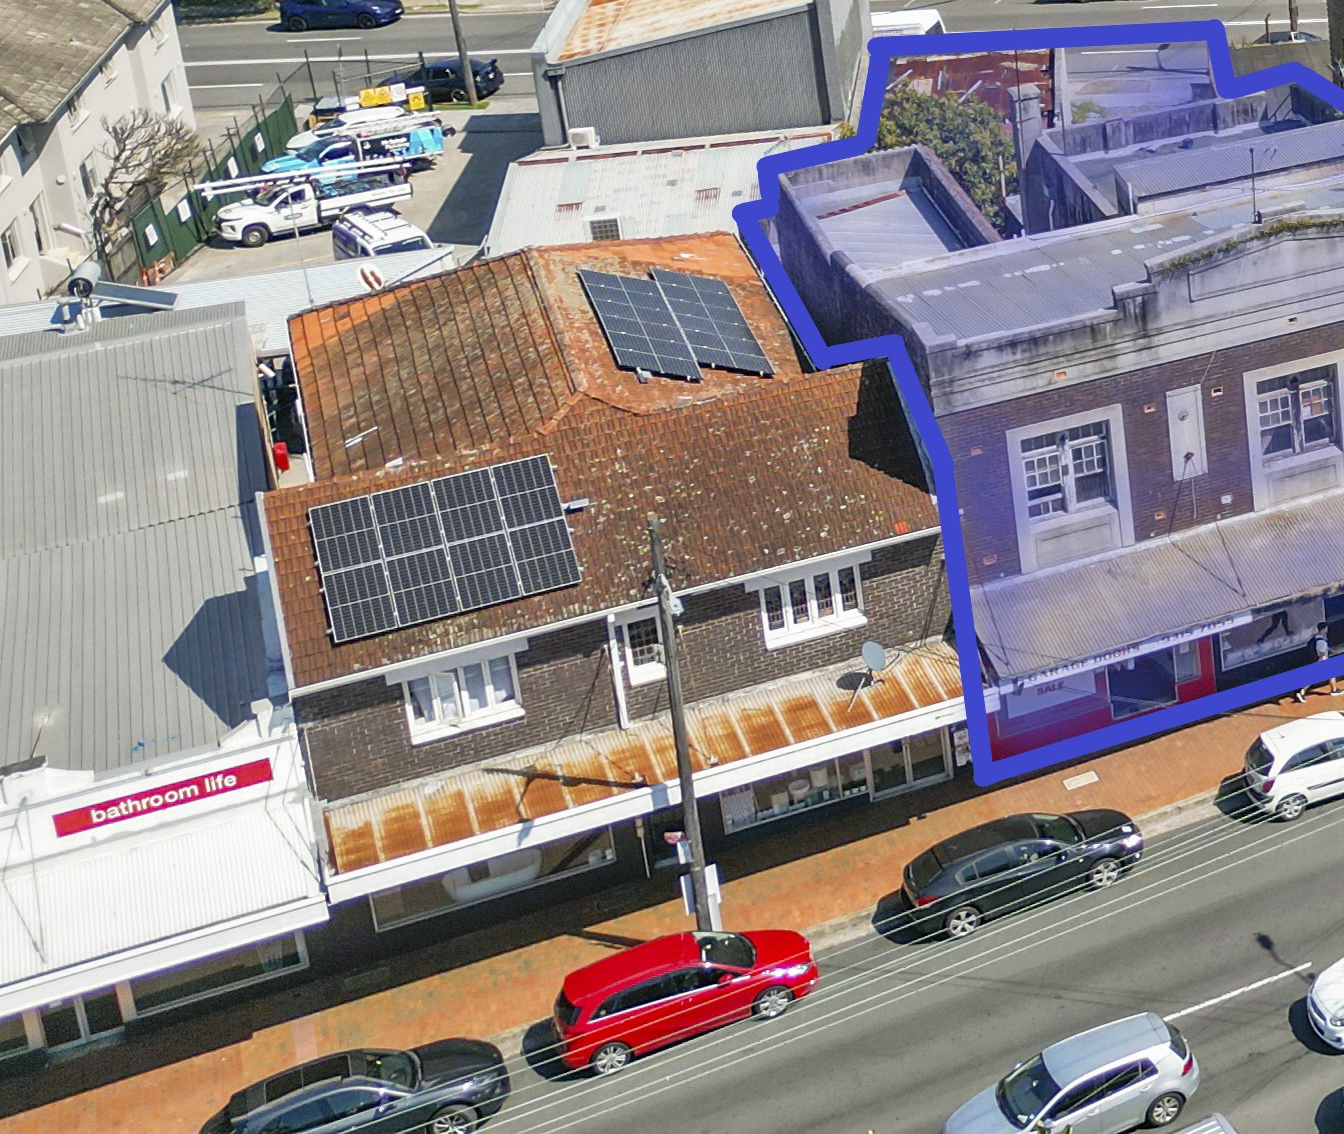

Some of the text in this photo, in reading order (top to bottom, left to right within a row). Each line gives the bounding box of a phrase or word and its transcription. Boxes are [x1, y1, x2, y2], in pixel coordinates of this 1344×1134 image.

[1037, 680, 1065, 695] SALE
[90, 773, 237, 824] bathroom life
